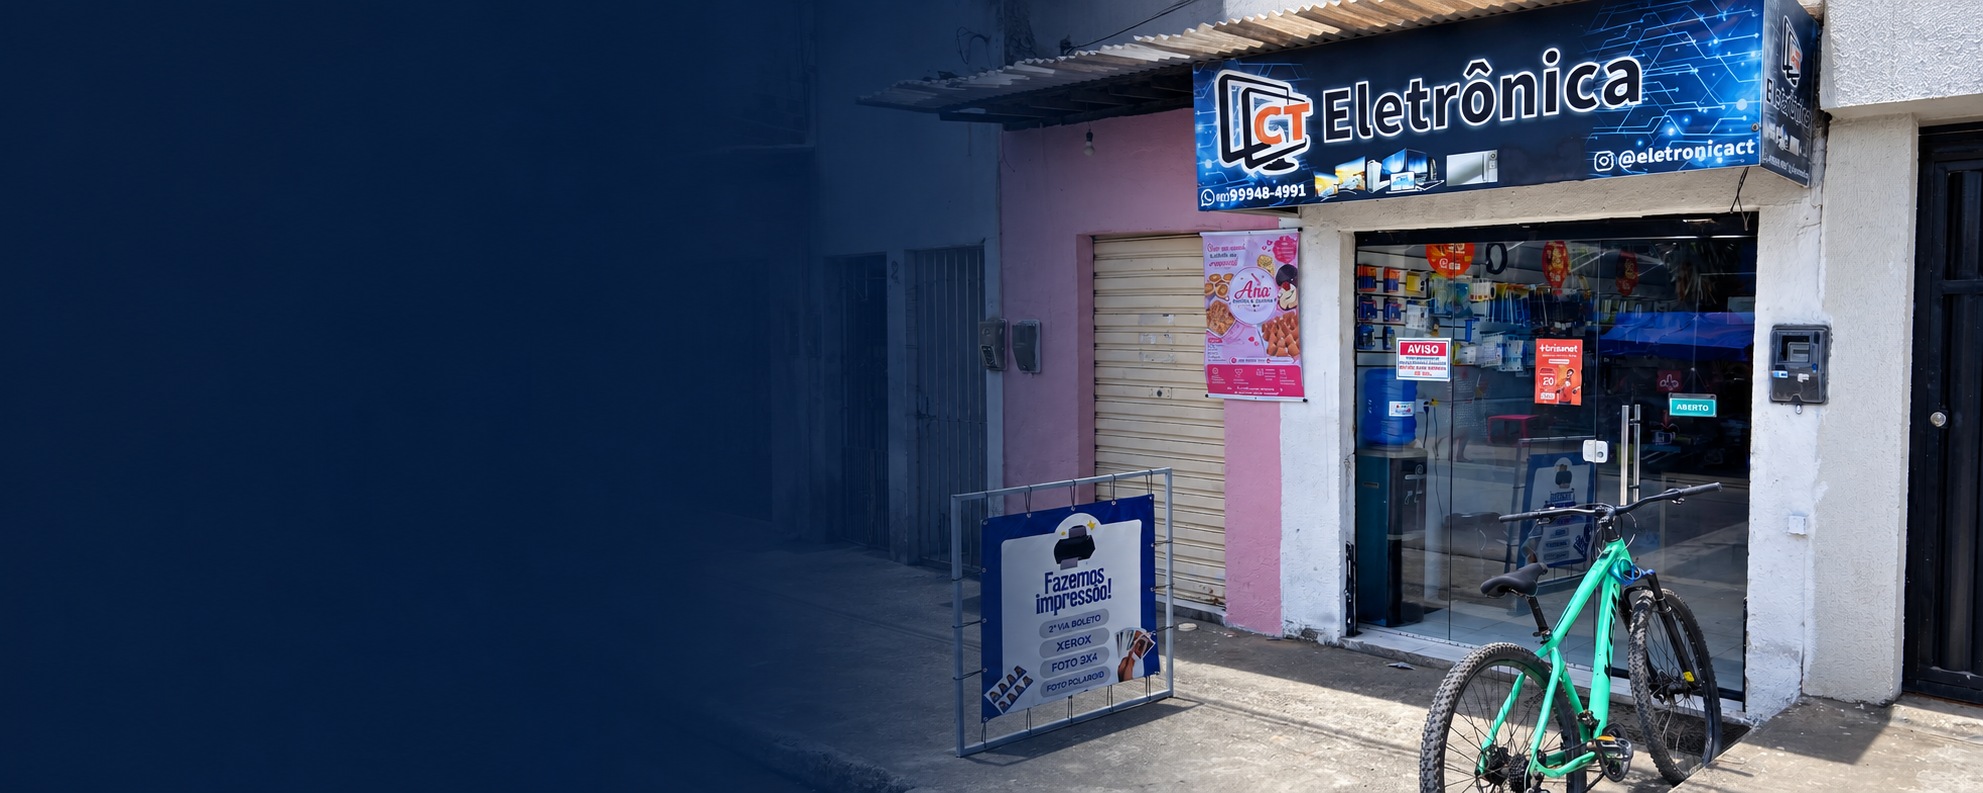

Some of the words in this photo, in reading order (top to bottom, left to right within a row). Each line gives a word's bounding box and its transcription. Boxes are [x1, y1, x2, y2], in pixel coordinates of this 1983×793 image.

[1323, 47, 1643, 143] Eletrônica
[1254, 102, 1310, 145] CT
[1618, 138, 1756, 168] @eletronicact
[1234, 280, 1270, 300] Ana
[1407, 344, 1439, 355] AVISO
[1542, 376, 1555, 386] 20
[1676, 403, 1709, 412] ABERTO
[1044, 567, 1105, 595] Fazemos
[1057, 622, 1070, 631] VIA
[1071, 614, 1101, 628] BOLETO
[1056, 634, 1092, 652] XEROX
[1051, 657, 1078, 673] FOTO
[1080, 652, 1098, 665] 3X4
[1046, 681, 1067, 693] FOTO
